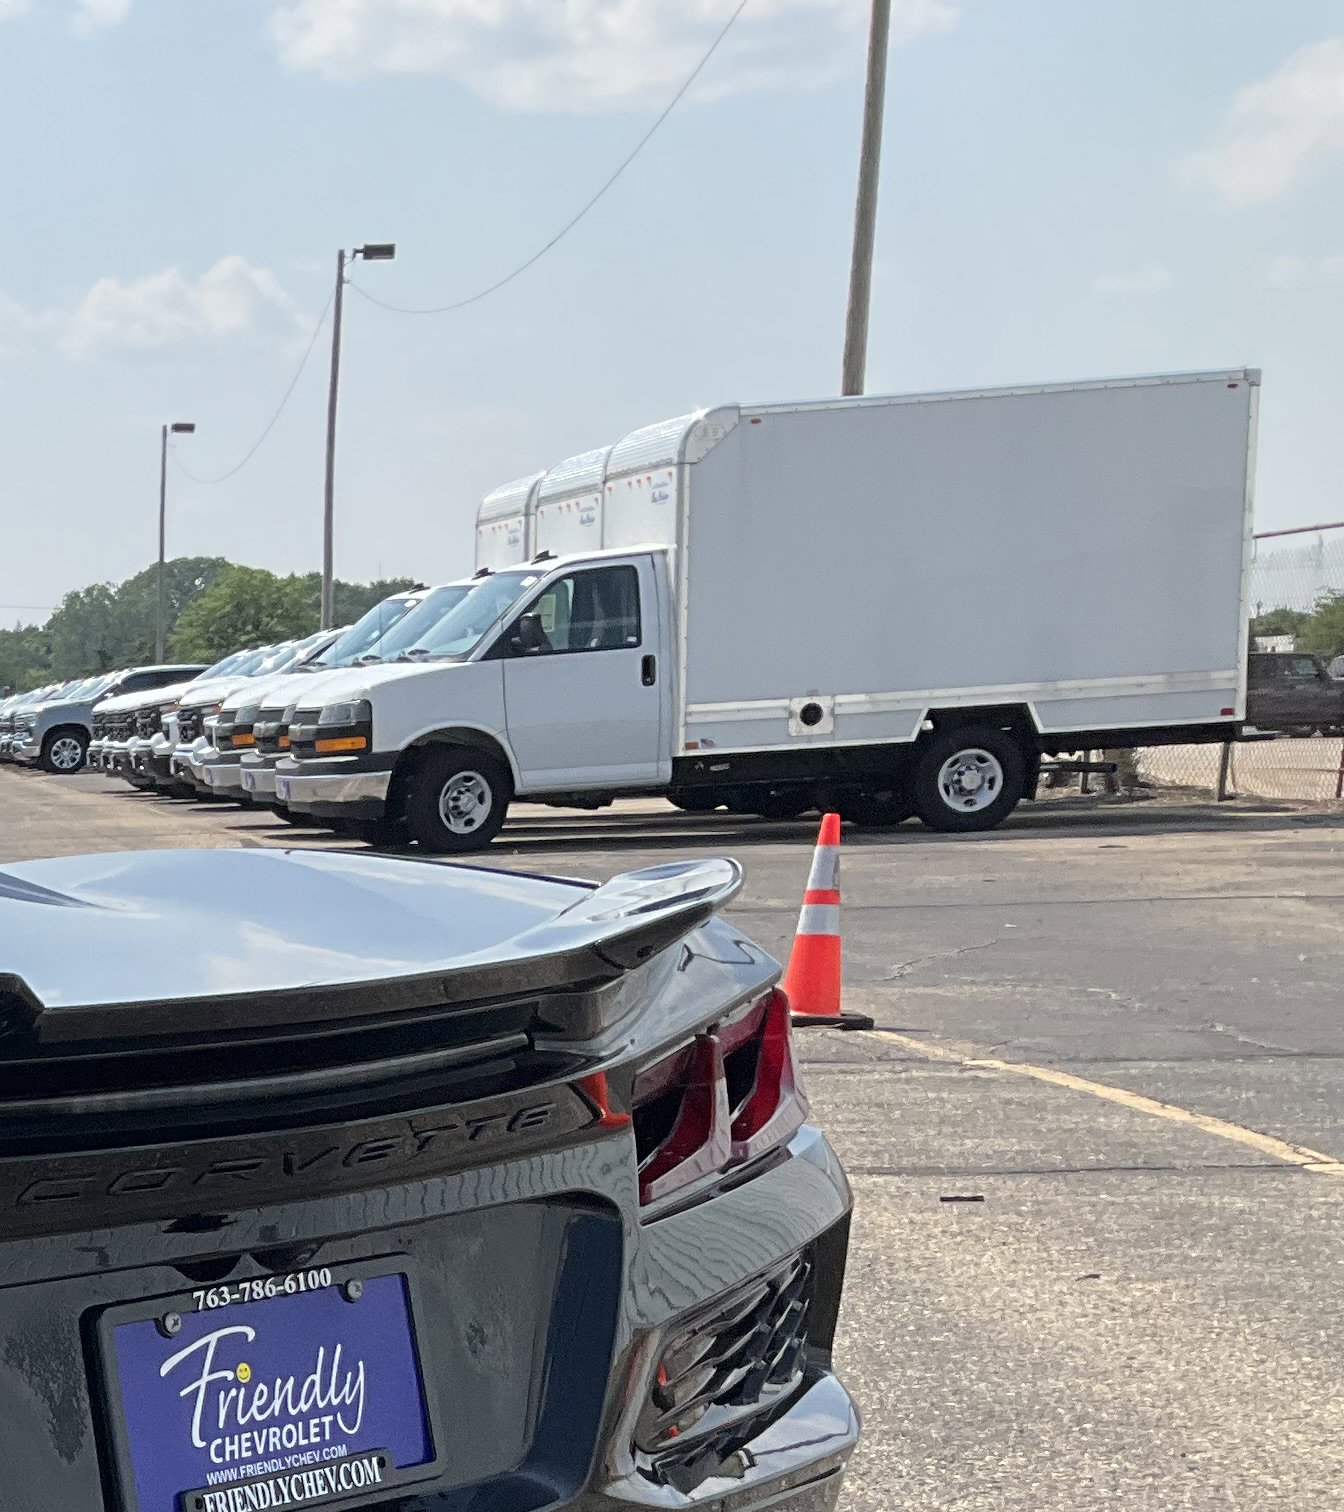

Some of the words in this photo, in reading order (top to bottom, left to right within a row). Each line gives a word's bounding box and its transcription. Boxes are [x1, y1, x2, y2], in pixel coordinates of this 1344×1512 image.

[16, 1102, 557, 1206] CORVETTE
[193, 1268, 331, 1310] 763-786-6100
[160, 1326, 364, 1447] Friendly
[210, 1415, 333, 1463] CHEVROLET
[206, 1444, 347, 1485] WWW.FRIENDLYCHEV.COM
